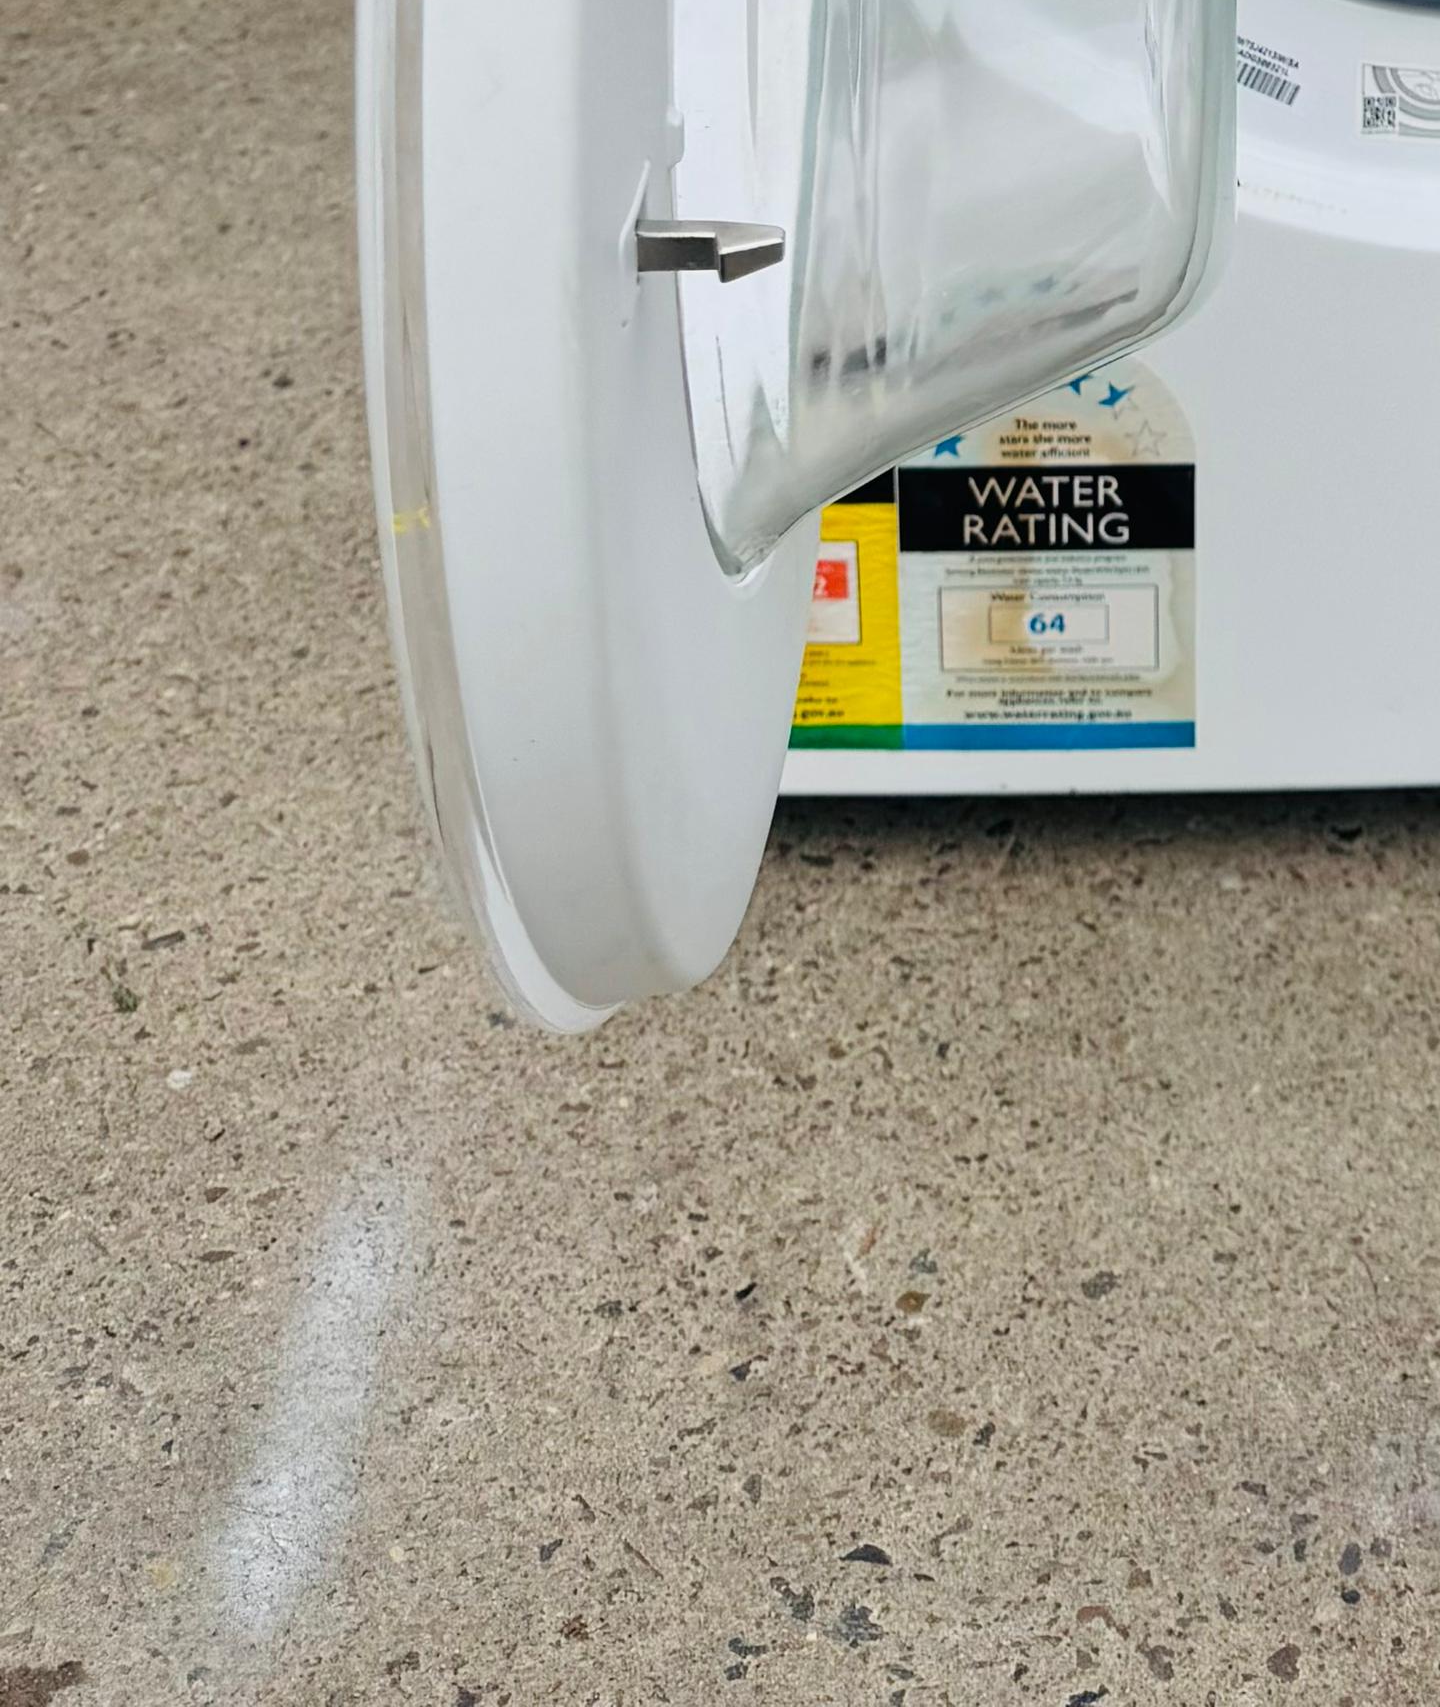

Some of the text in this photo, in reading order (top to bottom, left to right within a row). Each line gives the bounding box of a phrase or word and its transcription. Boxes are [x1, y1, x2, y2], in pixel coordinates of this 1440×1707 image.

[1015, 418, 1078, 430] The more
[1032, 433, 1054, 444] the
[1057, 434, 1092, 444] more
[967, 475, 1124, 510] WATER
[962, 512, 1131, 546] RATING
[1029, 612, 1066, 635] 64
